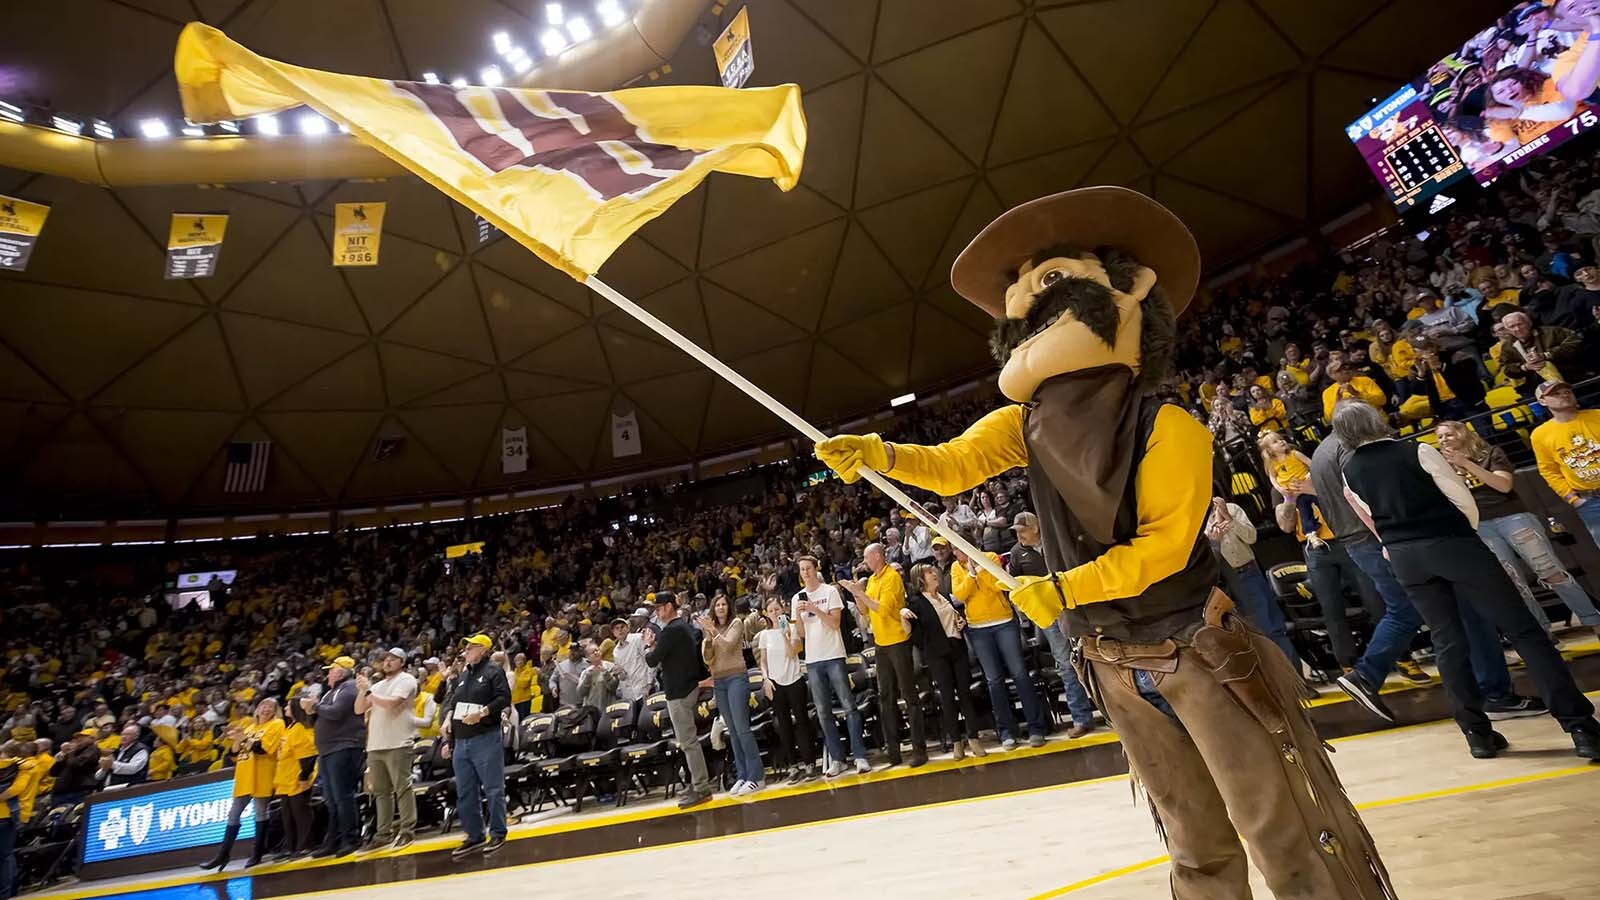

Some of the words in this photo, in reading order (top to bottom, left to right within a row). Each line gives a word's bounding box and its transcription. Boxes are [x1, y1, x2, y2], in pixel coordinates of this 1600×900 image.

[1373, 88, 1416, 121] WYOMING
[1503, 134, 1550, 164] WYOMING
[1564, 110, 1598, 135] 75
[348, 236, 367, 245] NIT
[621, 430, 630, 441] 4
[506, 445, 523, 456] 34
